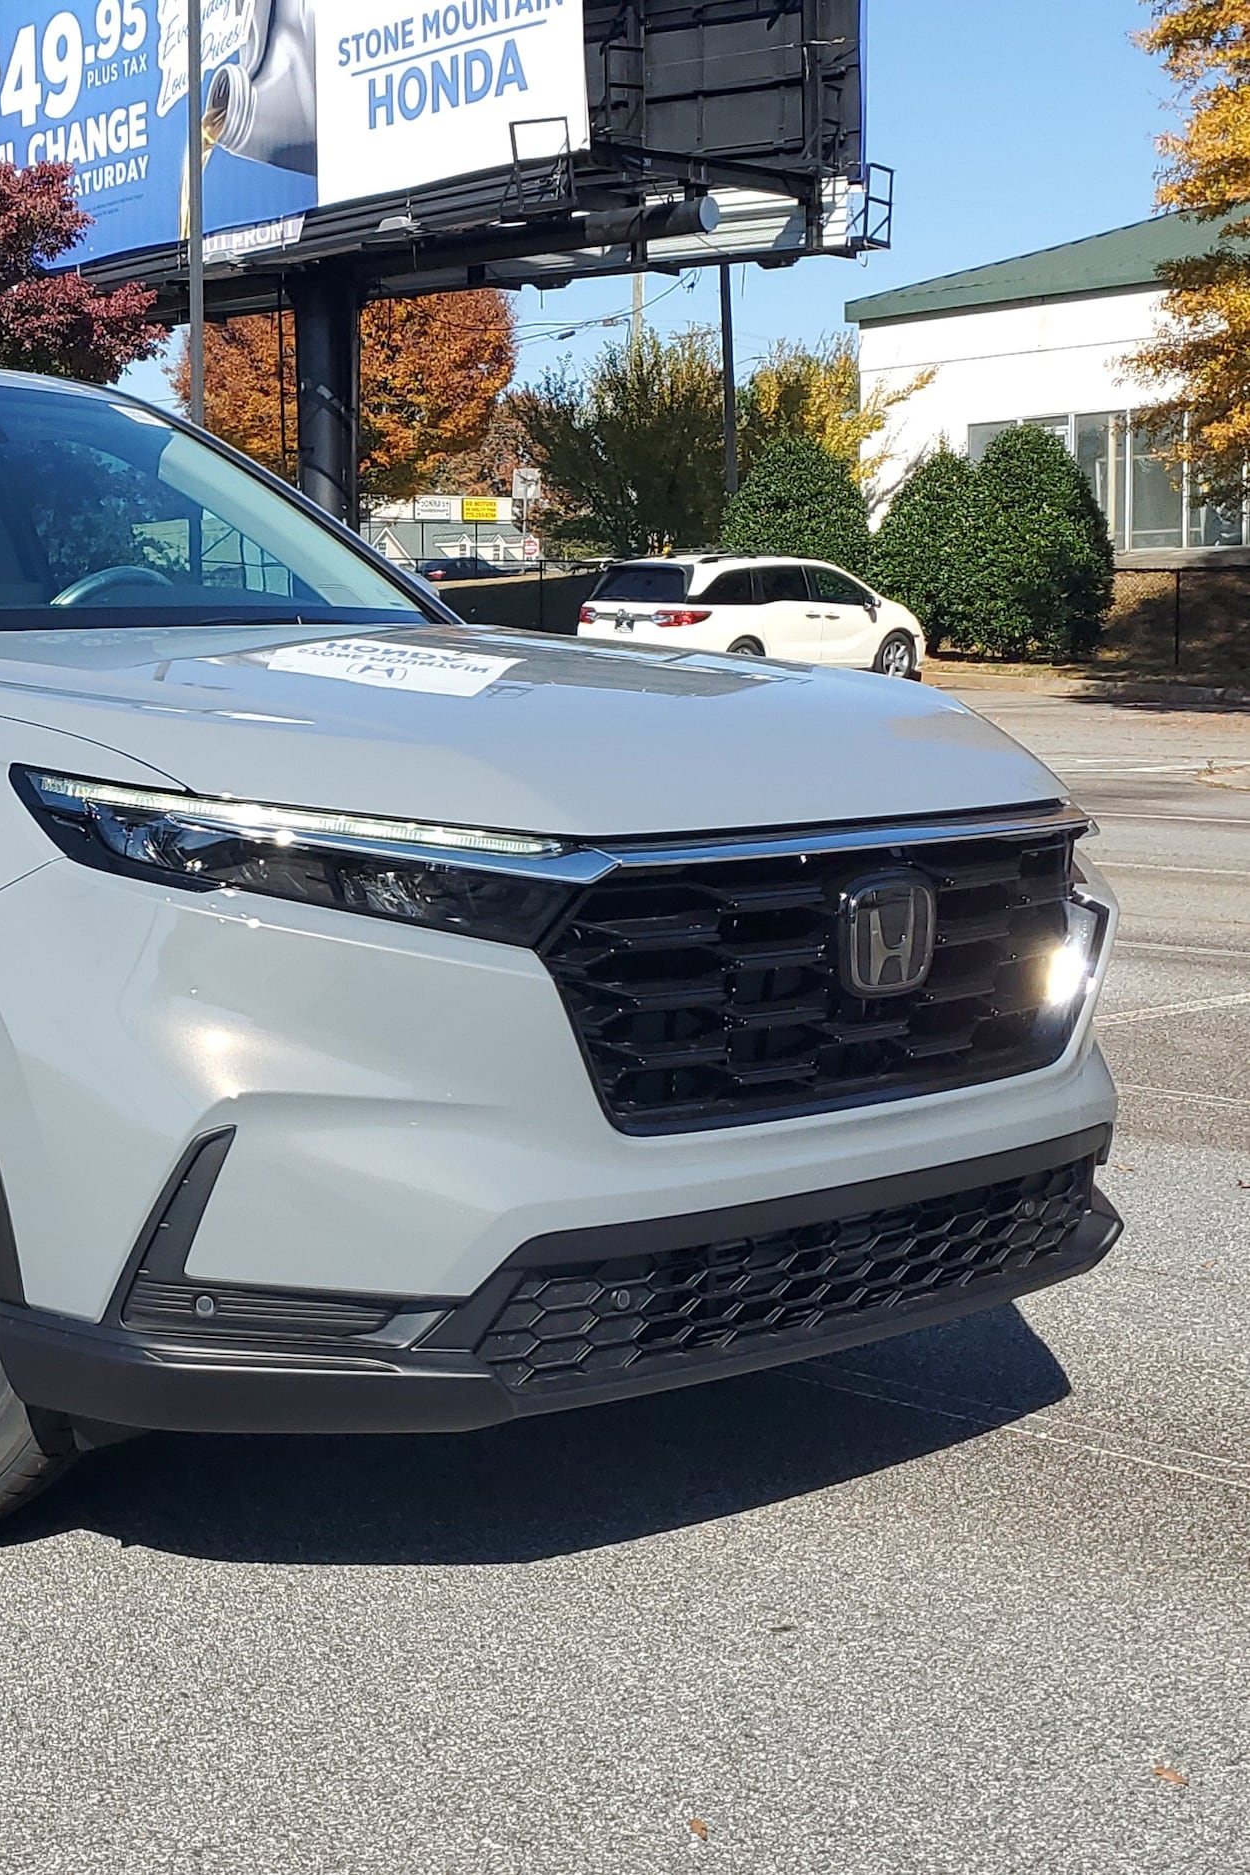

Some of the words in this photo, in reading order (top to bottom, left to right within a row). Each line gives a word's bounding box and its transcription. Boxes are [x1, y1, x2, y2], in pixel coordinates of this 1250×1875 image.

[338, 17, 414, 67] STONE
[87, 62, 119, 89] PLUS
[122, 53, 147, 78] TAX
[368, 38, 529, 130] HONDA
[28, 101, 148, 168] CHANGE
[65, 155, 149, 199] ATURDAY
[203, 219, 298, 252] UTFRONT
